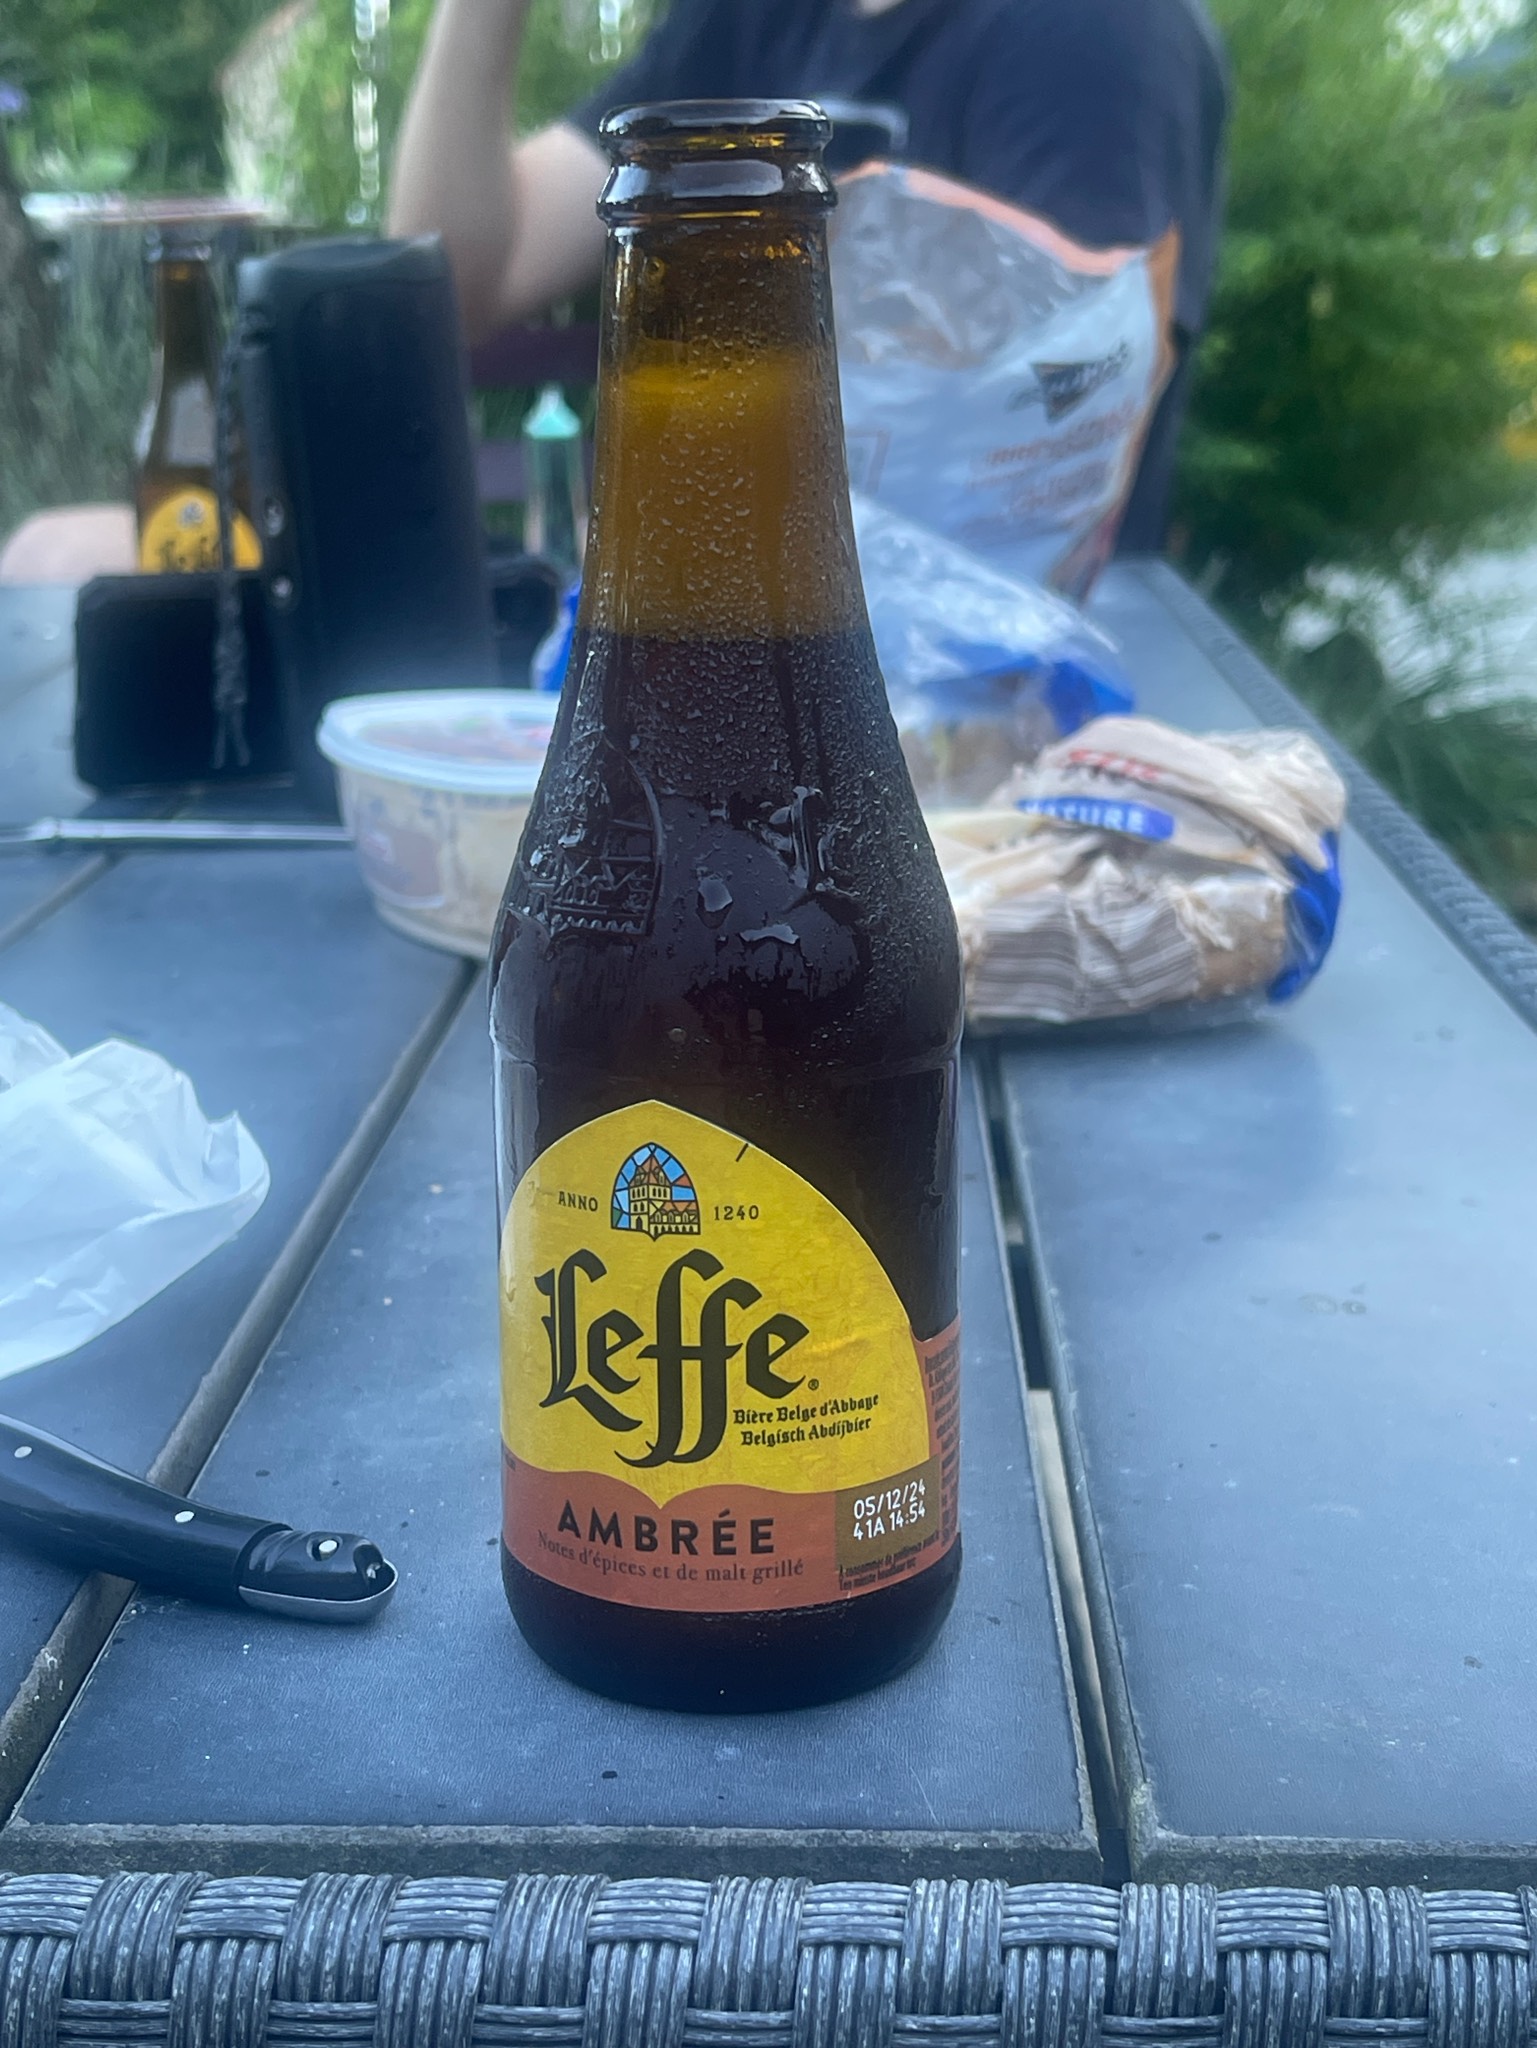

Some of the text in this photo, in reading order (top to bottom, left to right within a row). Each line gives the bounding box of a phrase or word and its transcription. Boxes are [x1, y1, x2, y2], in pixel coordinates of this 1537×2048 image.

[558, 1191, 759, 1221] ANNO 1240
[533, 1248, 810, 1469] Leffe
[733, 1394, 879, 1425] Bière Belge d'Abbaye
[741, 1417, 872, 1448] Belgisch Abdijbier
[853, 1478, 926, 1520] 05/12/24
[557, 1499, 775, 1556] AMBRÉE
[853, 1500, 926, 1541] 41A 14:54
[537, 1529, 804, 1585] Notes d'épices et de malt grillé
